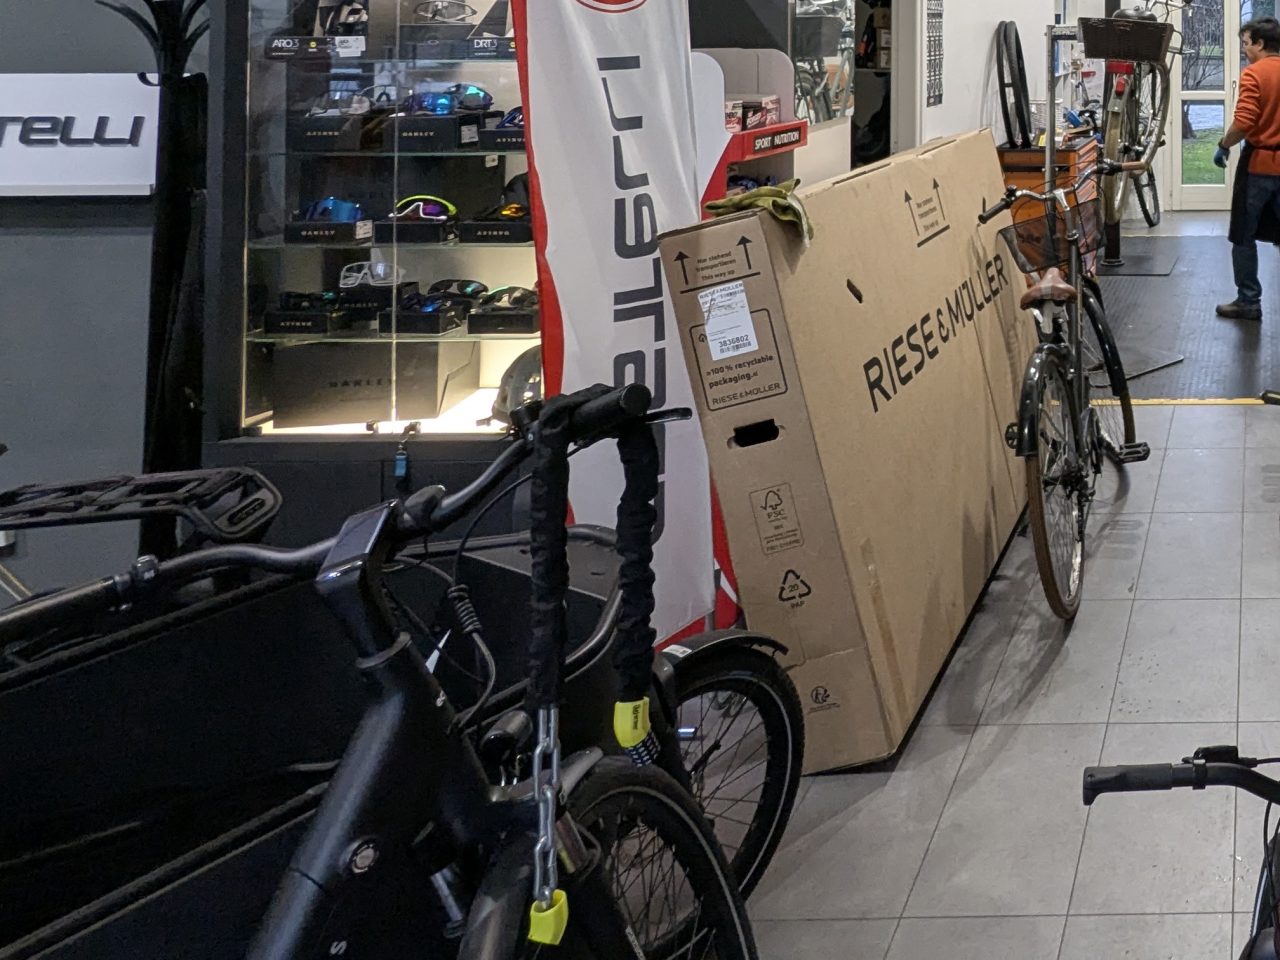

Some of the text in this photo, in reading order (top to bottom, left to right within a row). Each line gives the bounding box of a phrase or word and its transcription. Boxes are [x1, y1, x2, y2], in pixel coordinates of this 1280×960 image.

[755, 131, 800, 150] SPORT NUTRITION
[719, 335, 749, 348] 3836802
[735, 355, 774, 370] recyclable
[788, 582, 800, 593] 20
